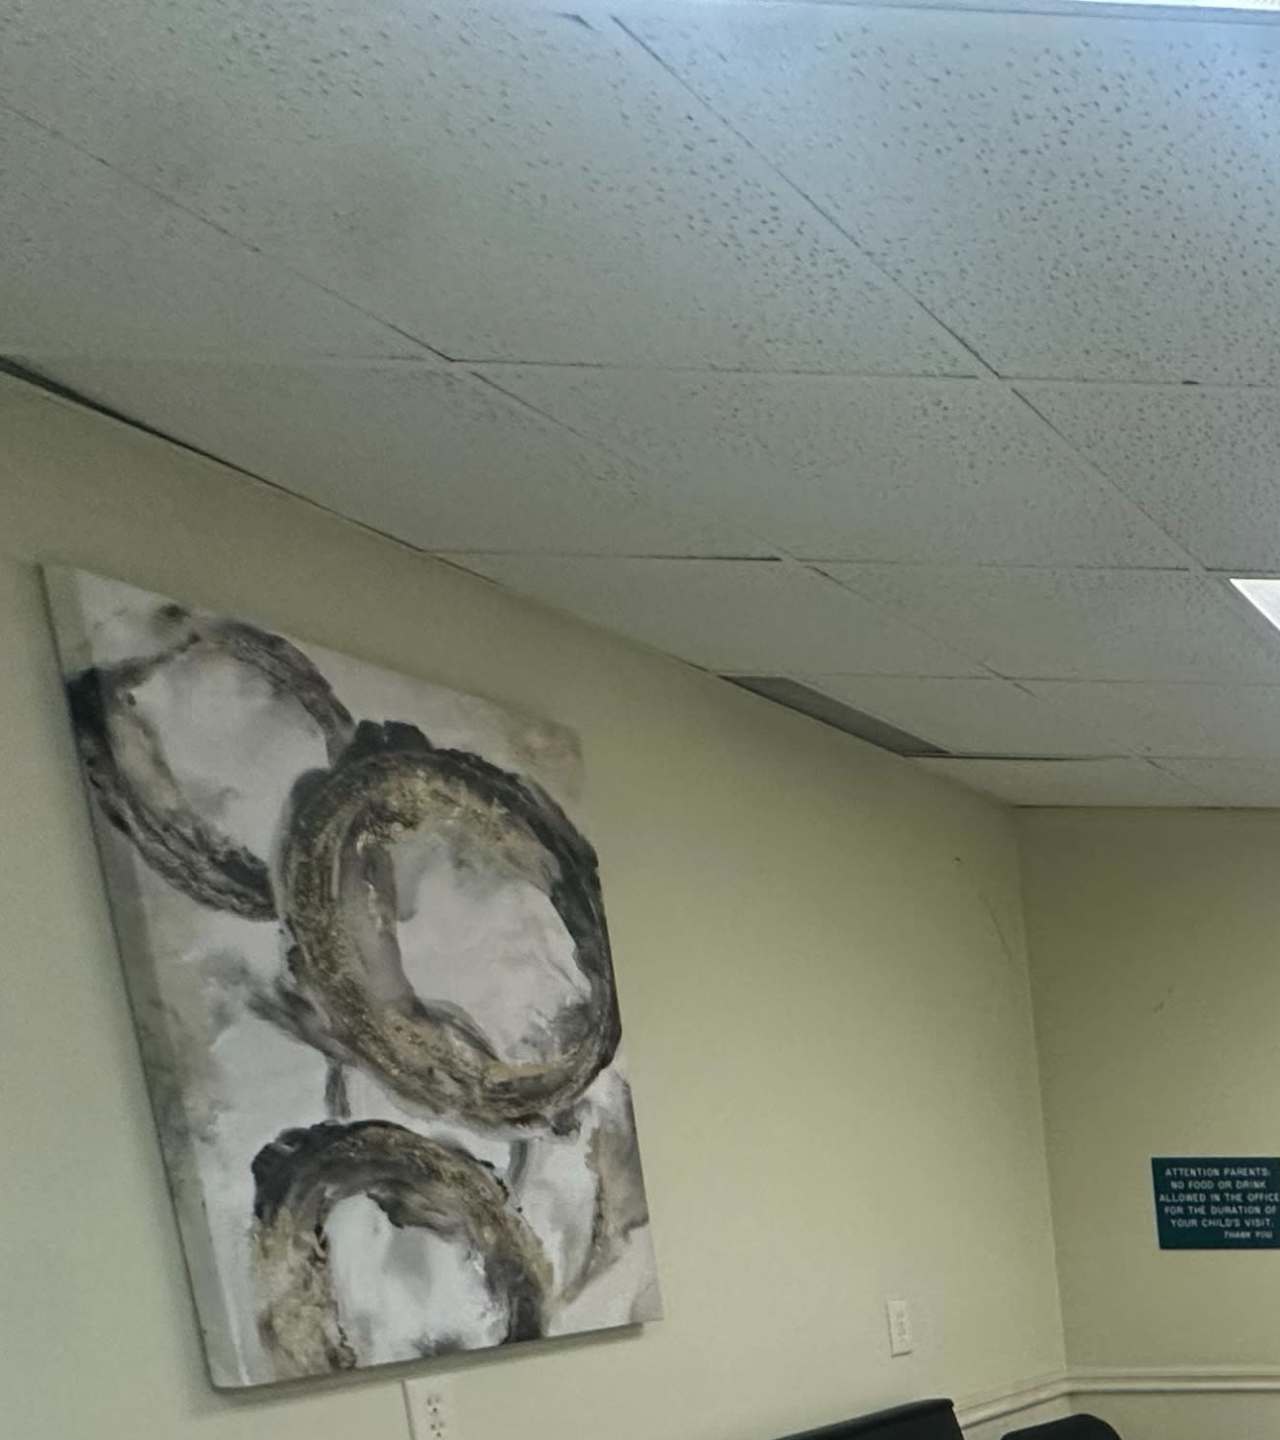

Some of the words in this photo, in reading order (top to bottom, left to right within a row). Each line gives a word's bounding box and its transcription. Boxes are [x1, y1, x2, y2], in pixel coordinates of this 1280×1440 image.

[1164, 1167, 1220, 1177] ATTENTION
[1170, 1180, 1185, 1190] NO
[1188, 1180, 1214, 1190] FOOD
[1217, 1180, 1233, 1190] OR
[1235, 1180, 1267, 1190] DRINK
[1159, 1193, 1207, 1202] ALLOWED
[1210, 1193, 1221, 1202] IN
[1224, 1193, 1243, 1202] THE
[1247, 1193, 1280, 1202] OFFICE
[1164, 1205, 1184, 1215] FOR
[1188, 1205, 1207, 1215] THE
[1210, 1205, 1261, 1215] DURATION
[1264, 1205, 1277, 1215] OF
[1170, 1218, 1198, 1228] YOUR
[1201, 1218, 1240, 1228] CHILD'S
[1223, 1231, 1251, 1239] THANK
